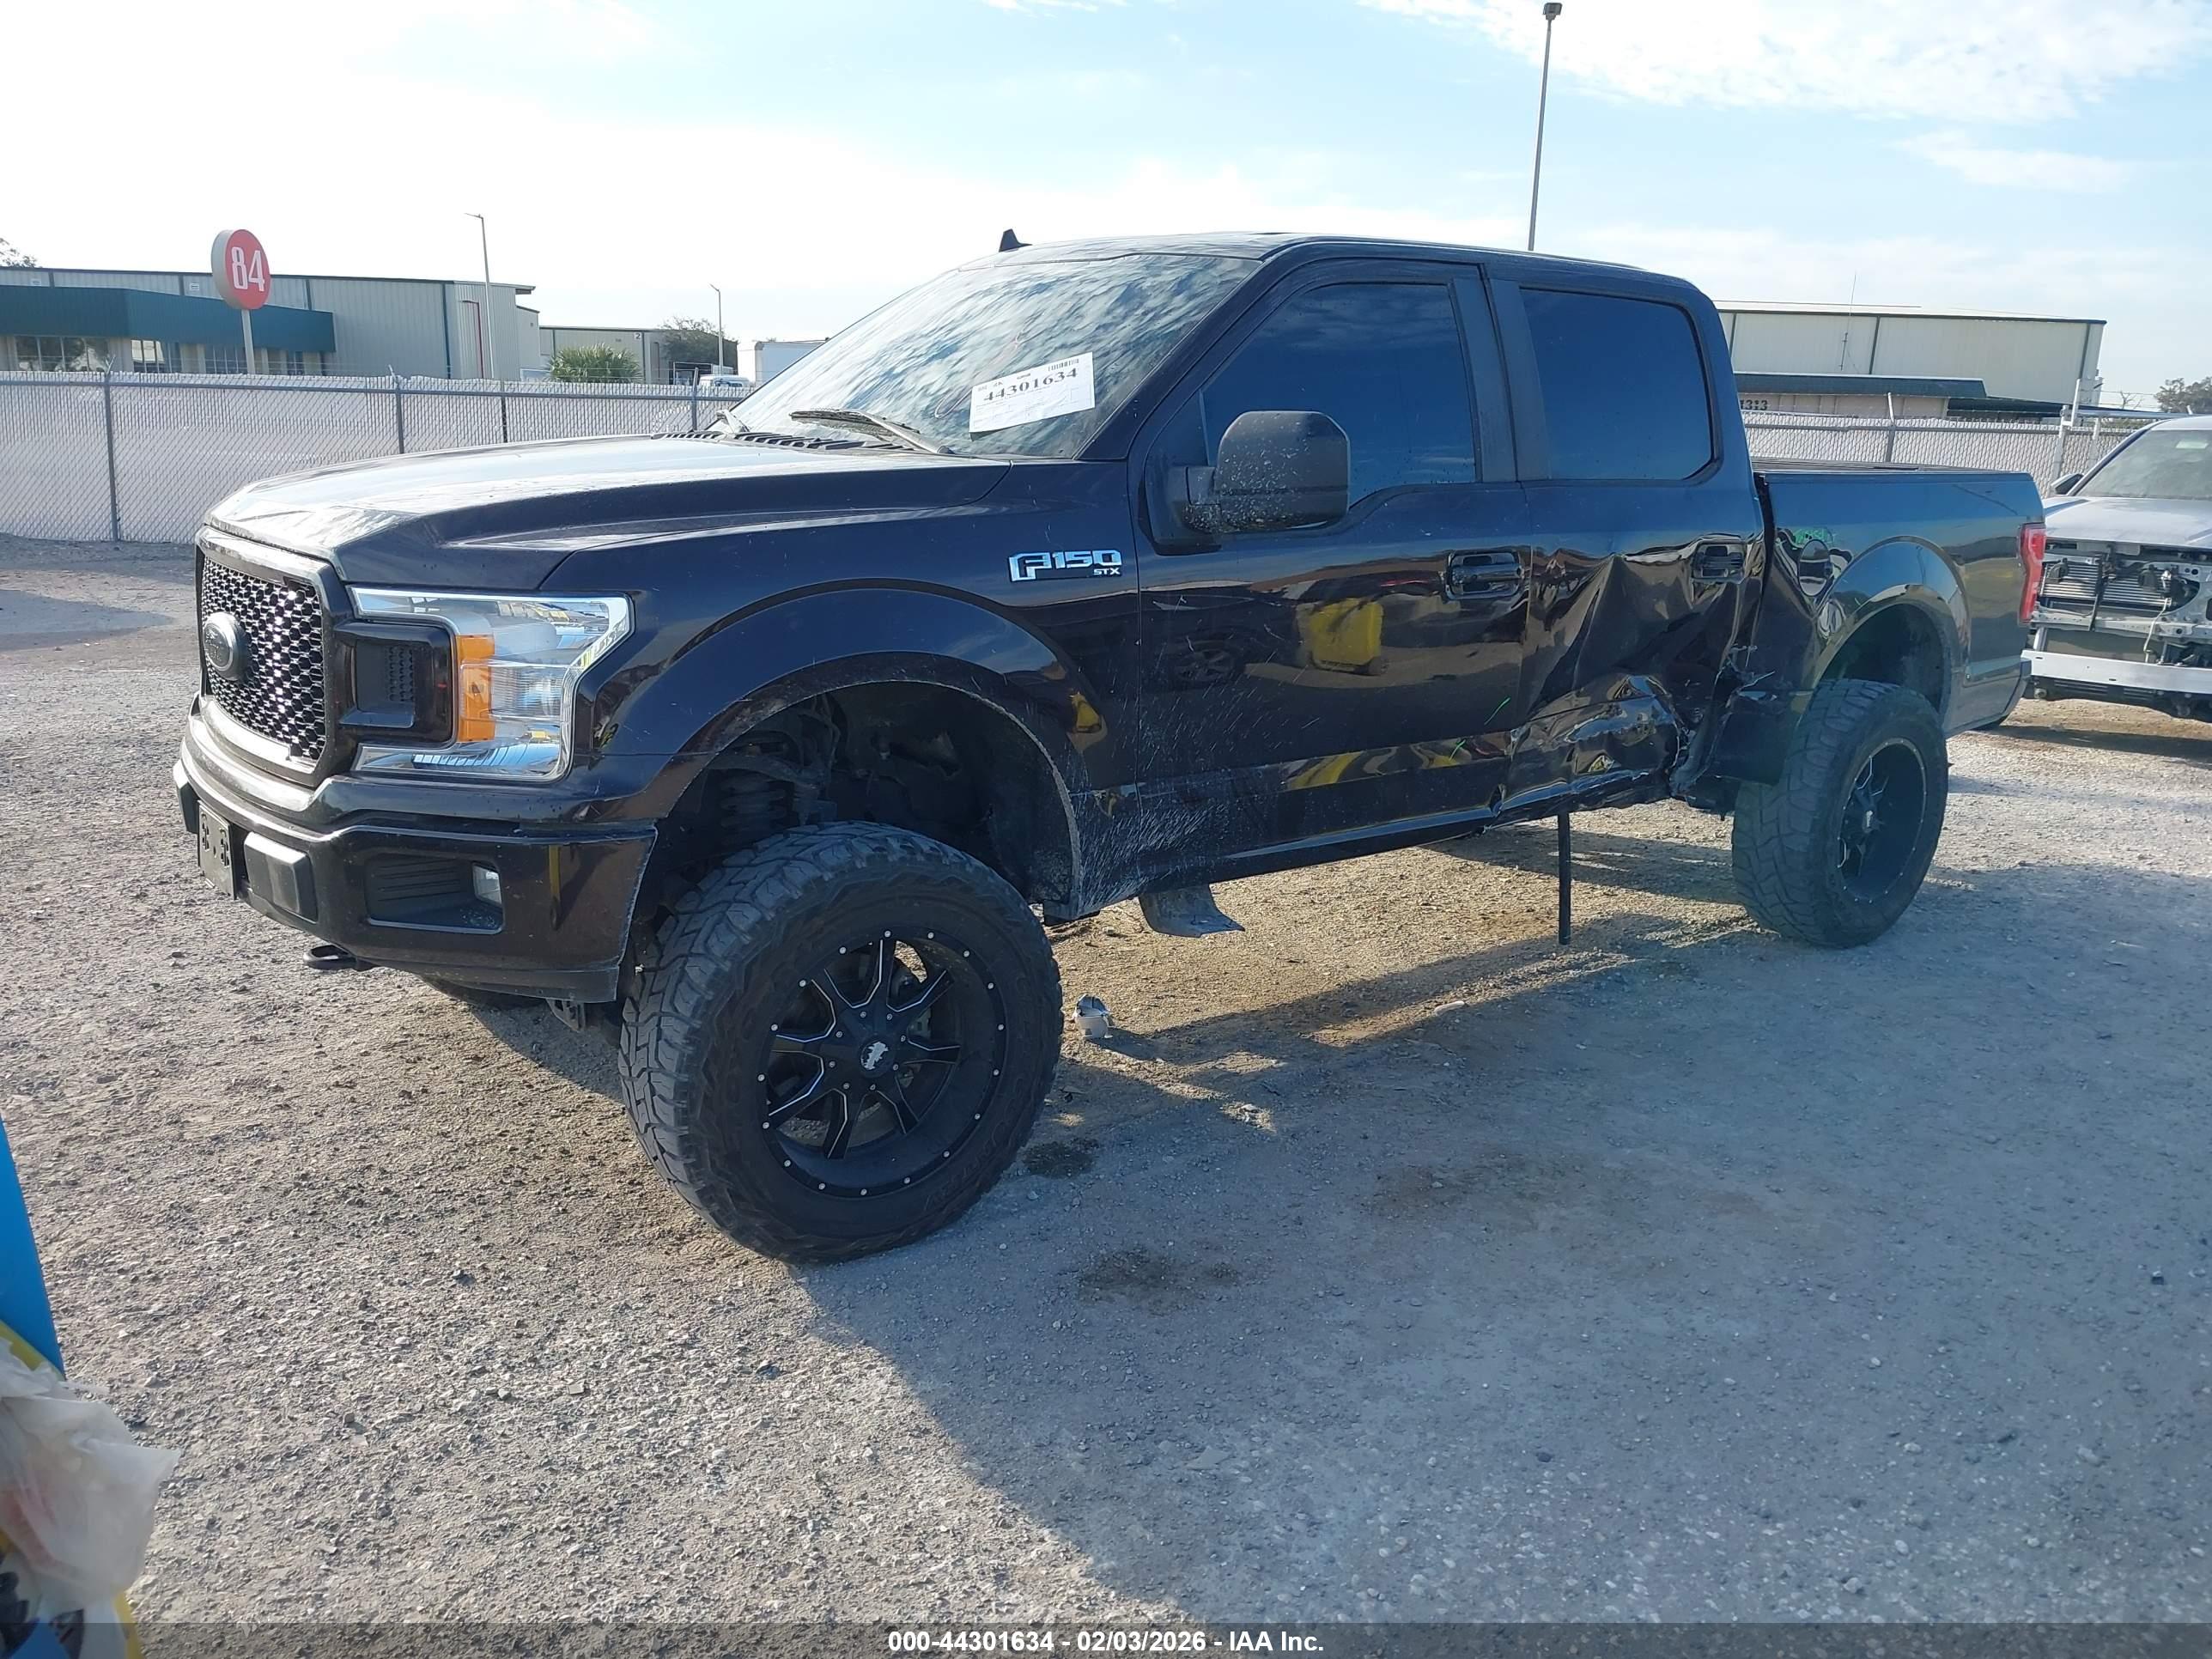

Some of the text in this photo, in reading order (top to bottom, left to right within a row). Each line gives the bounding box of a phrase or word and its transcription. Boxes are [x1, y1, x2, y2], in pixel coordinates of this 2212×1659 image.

[232, 246, 265, 292] 84
[983, 368, 1079, 401] 44301634
[1093, 568, 1121, 576] STX
